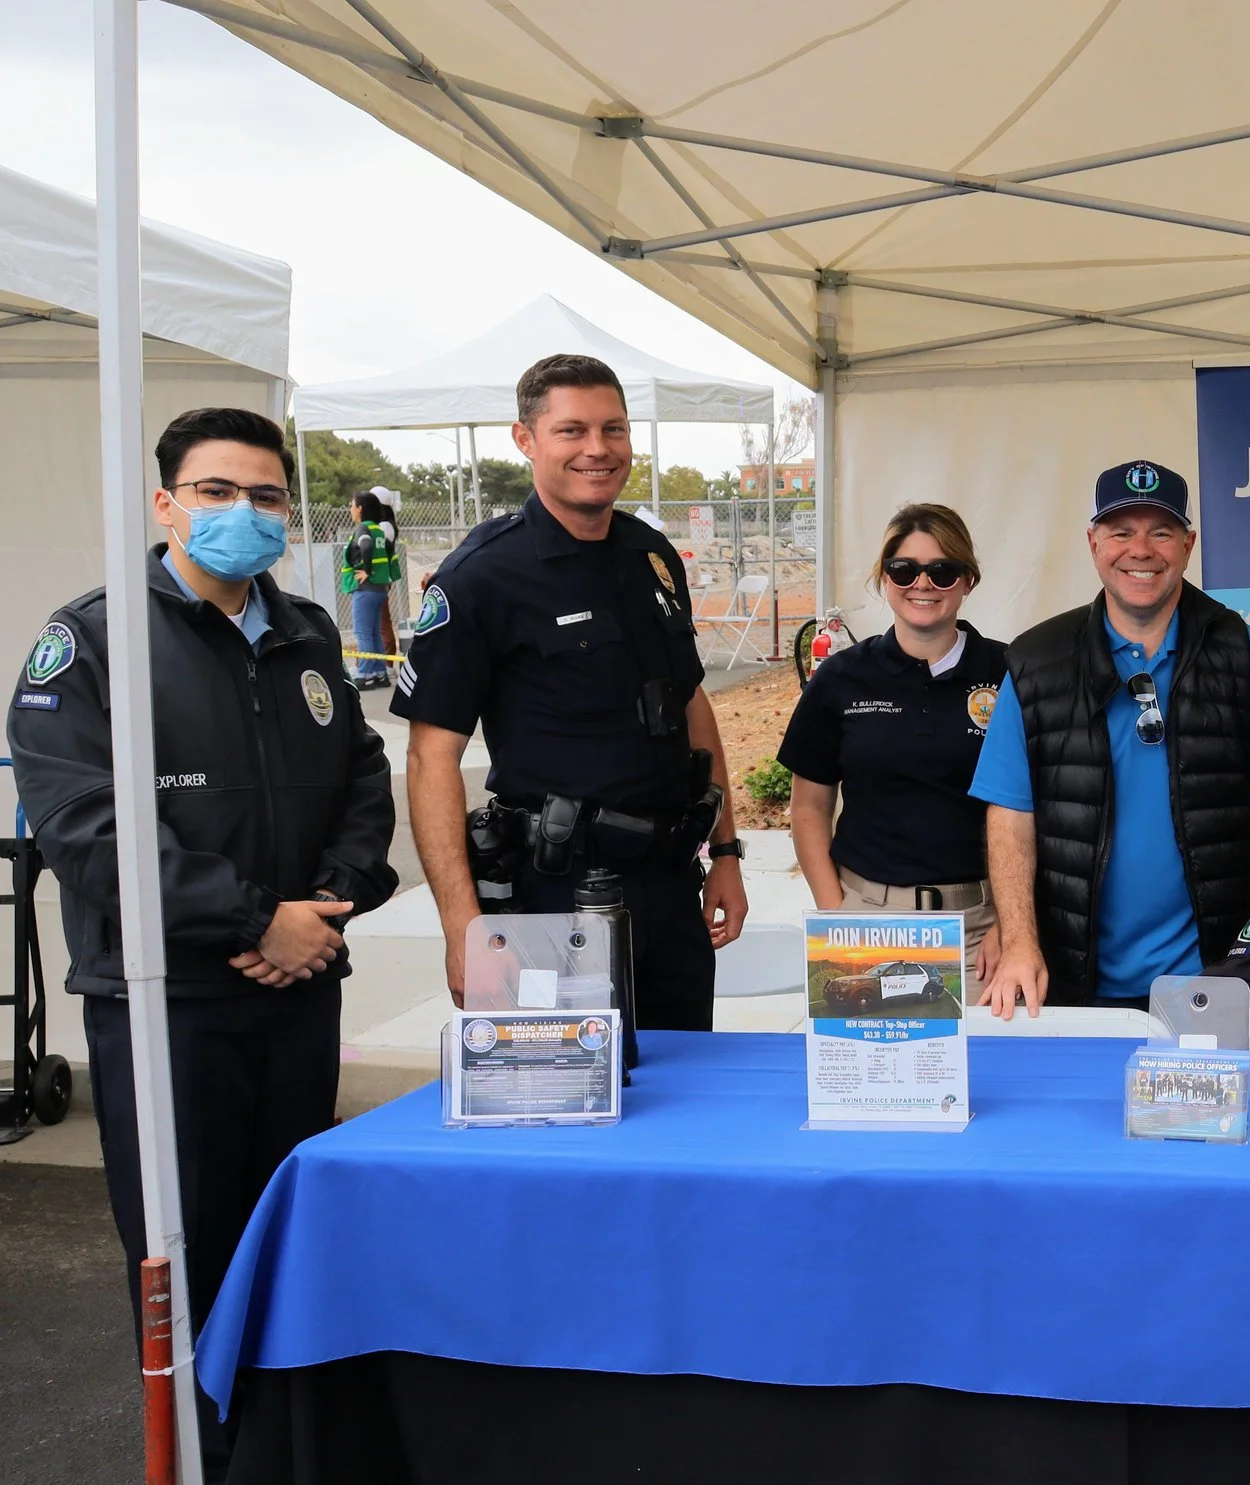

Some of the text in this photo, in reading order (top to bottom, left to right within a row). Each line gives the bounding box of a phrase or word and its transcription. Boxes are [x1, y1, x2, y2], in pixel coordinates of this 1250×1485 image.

[966, 683, 998, 693] IRVIN
[21, 694, 52, 705] EXPLORER
[967, 728, 986, 736] POL
[825, 927, 943, 948] JOIN IRVINE PD
[505, 1025, 536, 1033] PUBLIC
[845, 1020, 857, 1029] NEW
[908, 1021, 926, 1029] Officer
[1138, 1060, 1157, 1068] NOW
[1206, 1064, 1238, 1072] OFFICERS
